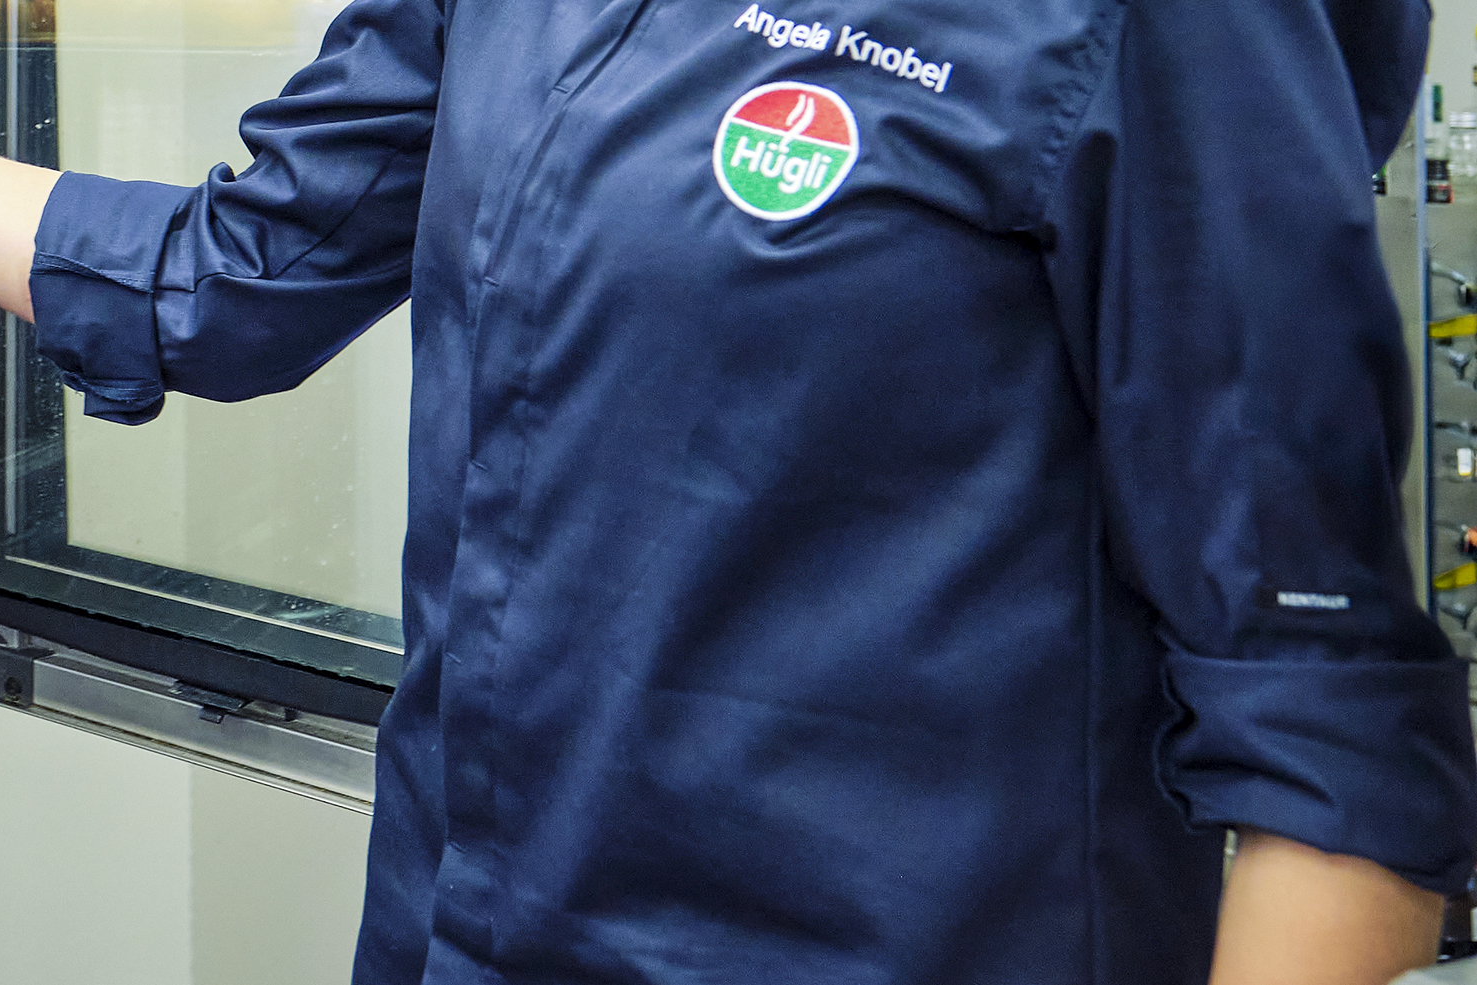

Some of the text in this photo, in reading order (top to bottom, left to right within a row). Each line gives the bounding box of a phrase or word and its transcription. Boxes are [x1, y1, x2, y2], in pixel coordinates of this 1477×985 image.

[733, 3, 953, 93] Angela Knobel
[730, 136, 833, 194] Hügli
